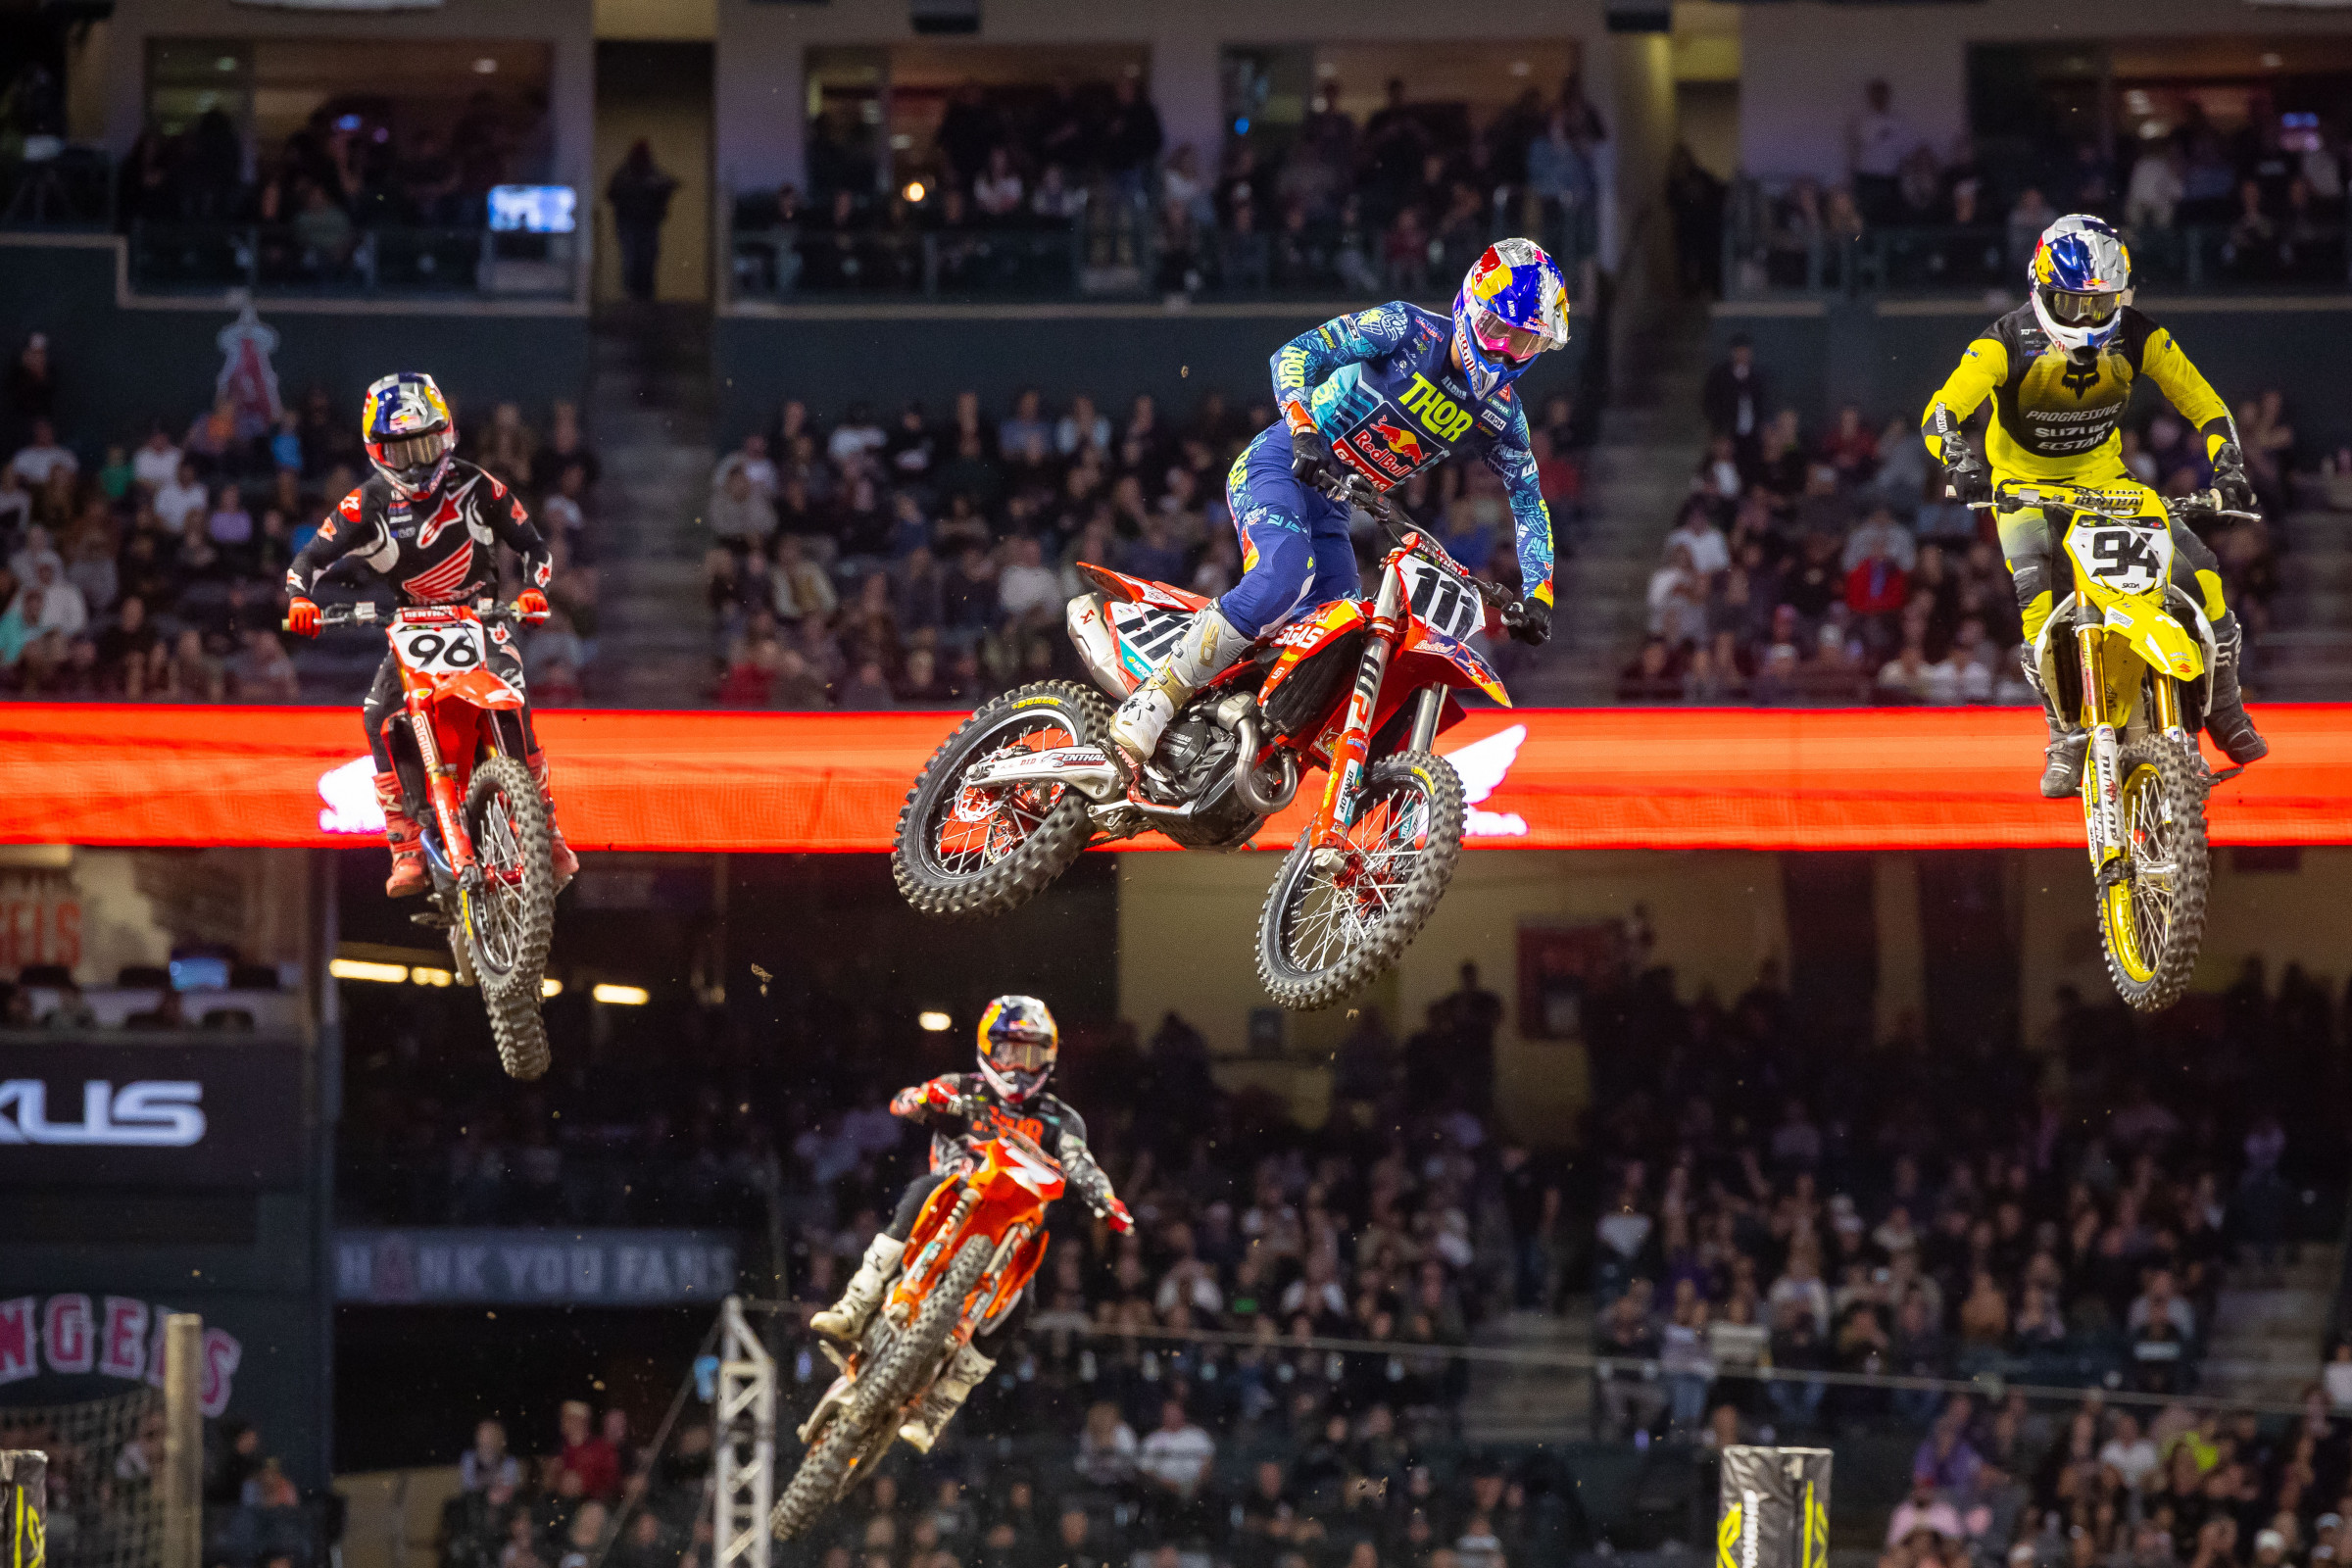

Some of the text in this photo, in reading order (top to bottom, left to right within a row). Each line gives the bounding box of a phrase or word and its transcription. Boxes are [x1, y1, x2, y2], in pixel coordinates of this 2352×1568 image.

[1279, 346, 1310, 391] THOR
[1398, 371, 1473, 442] THOR
[1484, 411, 1506, 430] AIROH
[2026, 402, 2123, 422] PROGRESSIVE
[2037, 431, 2106, 451] ECSTAR
[2091, 531, 2162, 578] 94
[1411, 566, 1479, 643] 111
[408, 634, 479, 668] 96
[500, 1245, 605, 1295] YOU
[617, 1245, 737, 1296] FANS
[0, 1293, 243, 1419] NGES
